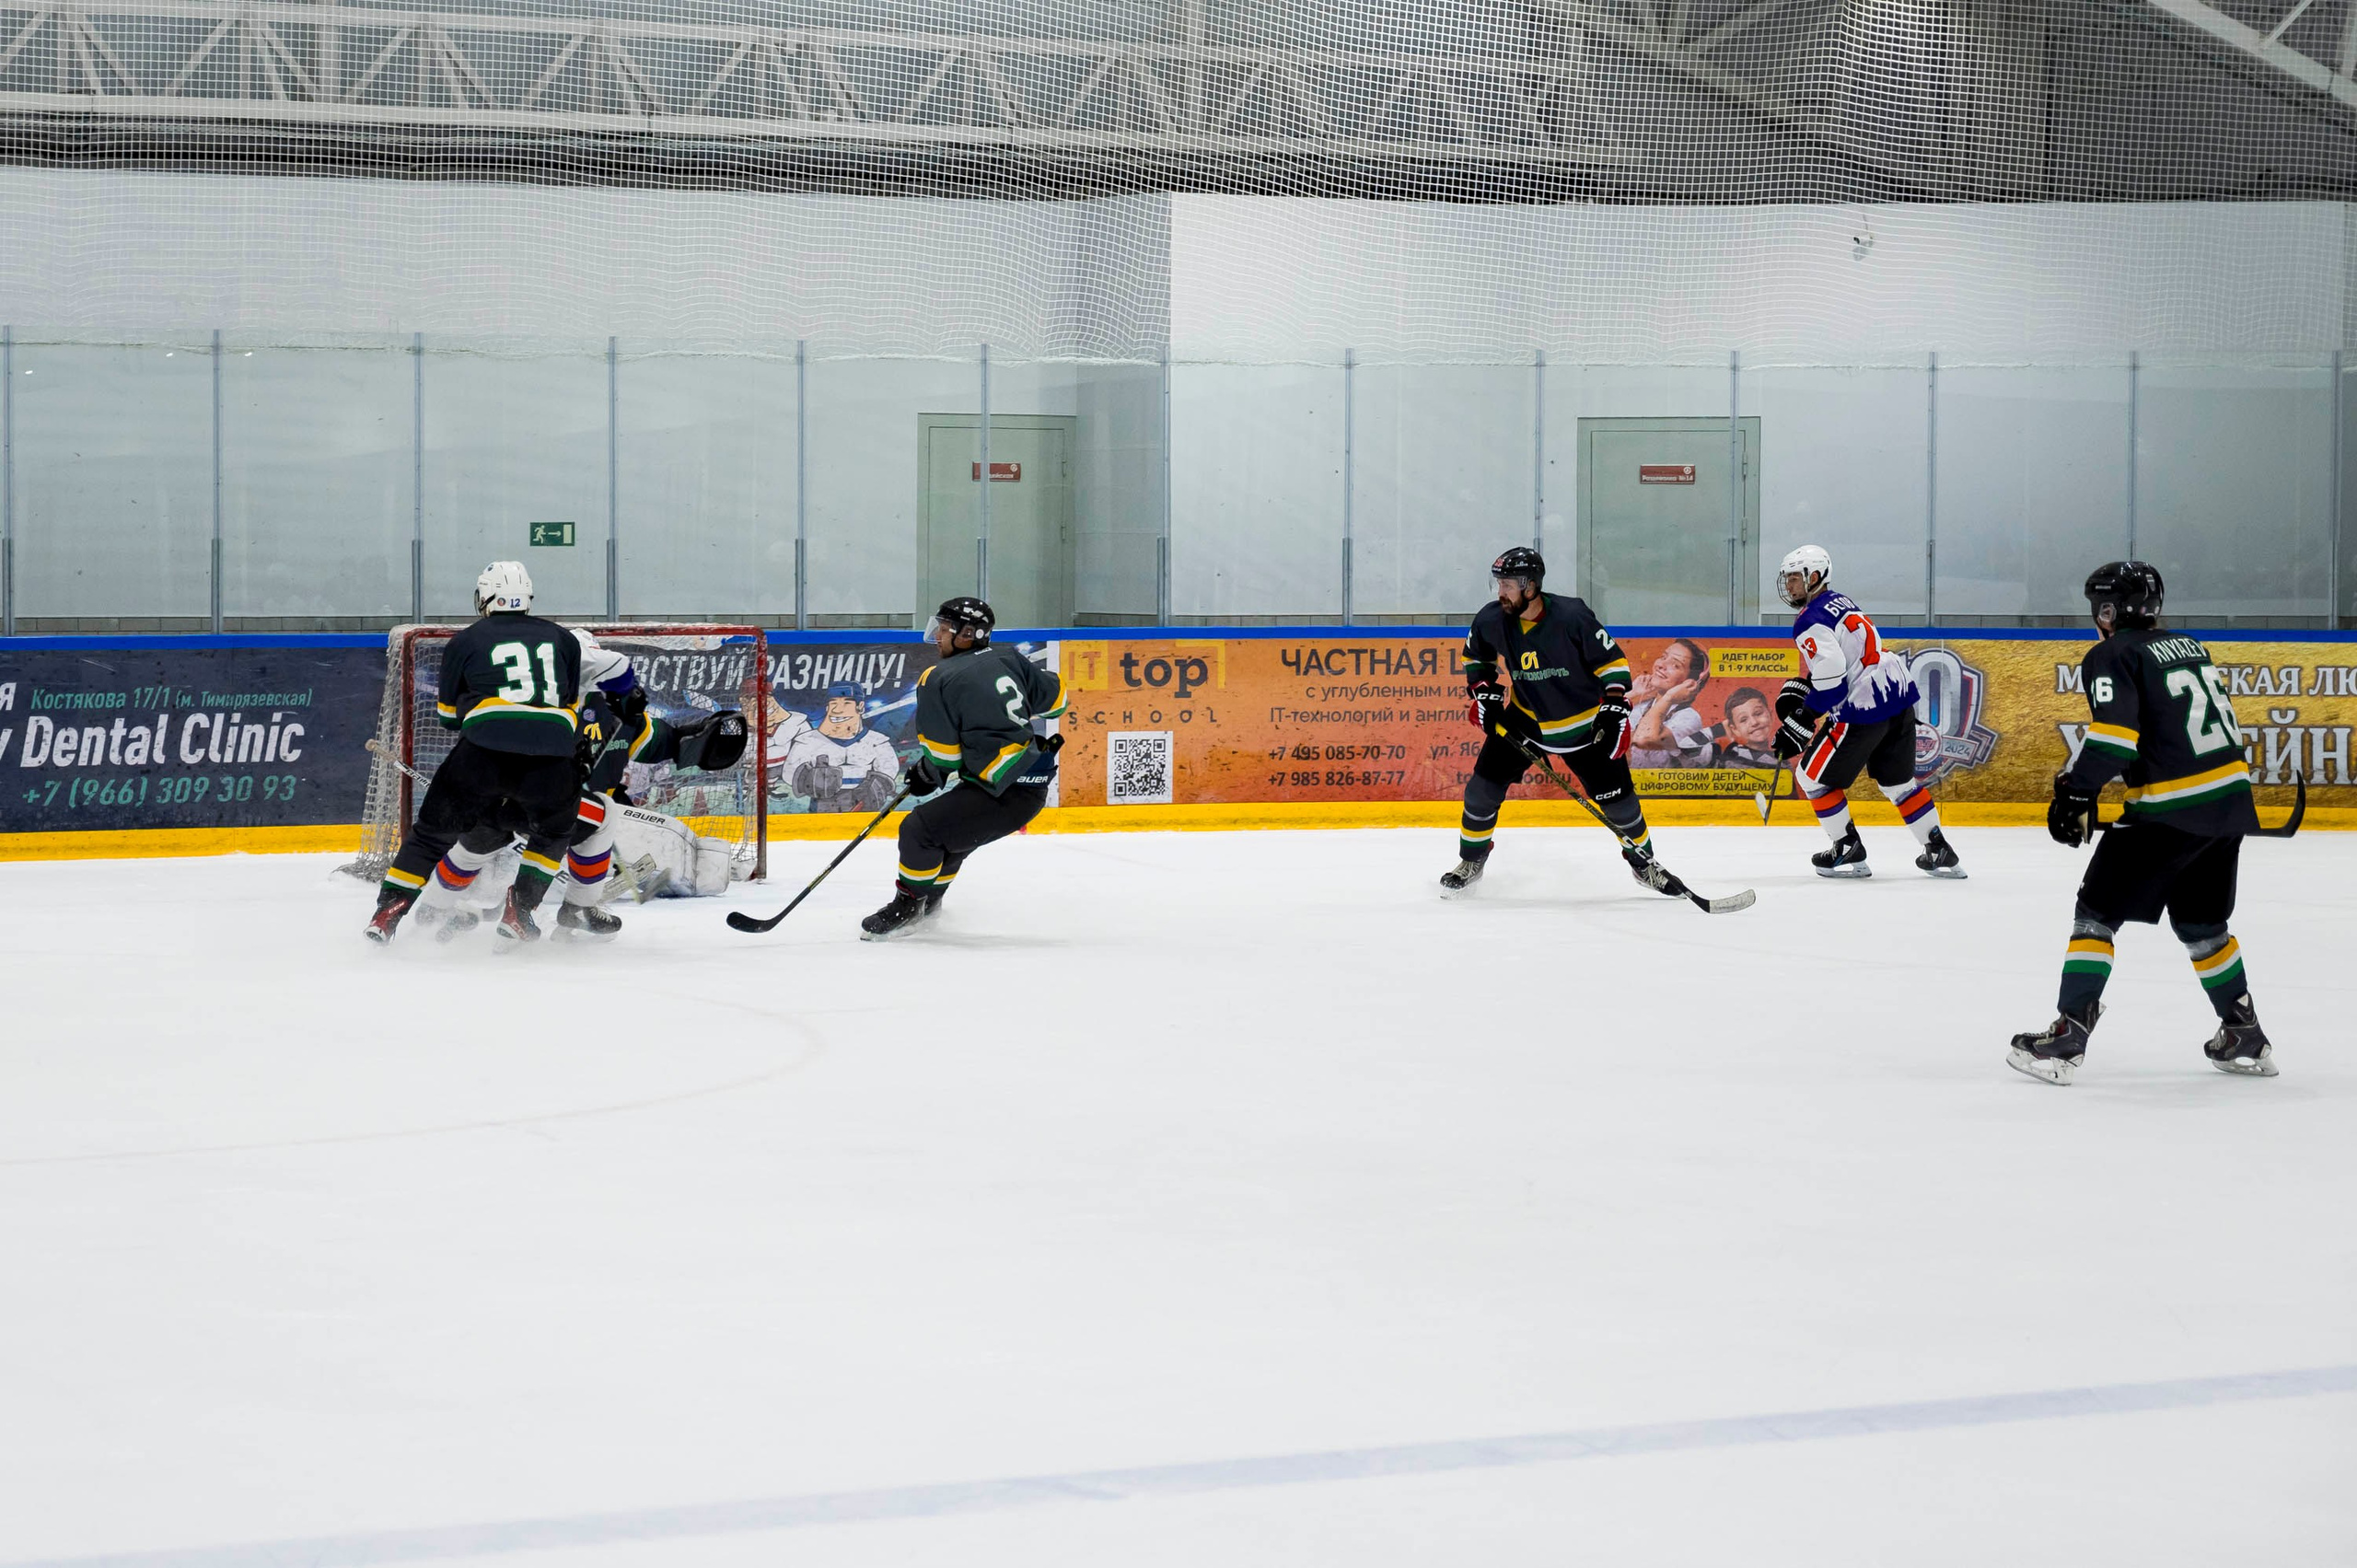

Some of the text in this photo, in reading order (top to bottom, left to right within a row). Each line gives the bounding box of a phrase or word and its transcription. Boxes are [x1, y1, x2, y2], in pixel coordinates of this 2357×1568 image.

[510, 598, 521, 608] 12
[1722, 653, 1785, 662] ИДЕТ НАБОР
[2147, 637, 2208, 665] KNYAZEV
[631, 647, 748, 691] ВСТВУЙ
[1282, 648, 1437, 677] ЧАСТНАЯ
[1728, 664, 1743, 673] 1-9
[1746, 664, 1789, 672] КЛАССЫ
[490, 641, 560, 708] 31
[1068, 651, 1209, 698] IT top
[30, 689, 126, 710] Костякова
[134, 687, 169, 708] 17/1
[201, 688, 313, 711] Тимирязевская)
[1306, 687, 1316, 698] с
[1321, 682, 1441, 702] углубленным
[1068, 707, 1217, 725] SCHOOL
[1270, 706, 1393, 725] IT-технологий
[1399, 709, 1411, 722] и
[1599, 704, 1631, 716] CCM
[2165, 665, 2243, 757] 26
[20, 714, 169, 768] Dental
[180, 713, 305, 764] Clinic
[1269, 745, 1406, 761] +7 495 085-70-70
[1430, 745, 1454, 761] ул.
[1945, 742, 1970, 757] 2024
[1268, 771, 1405, 786] +7 985 826-87-77
[1658, 772, 1746, 782] ГОТОВИМ ДЕТЕЙ
[22, 774, 296, 808] +7 (966) 309 30 93
[1596, 787, 1620, 801] CCM
[1713, 783, 1773, 792] БУДУЩЕМУ
[623, 809, 666, 825] BAUER
